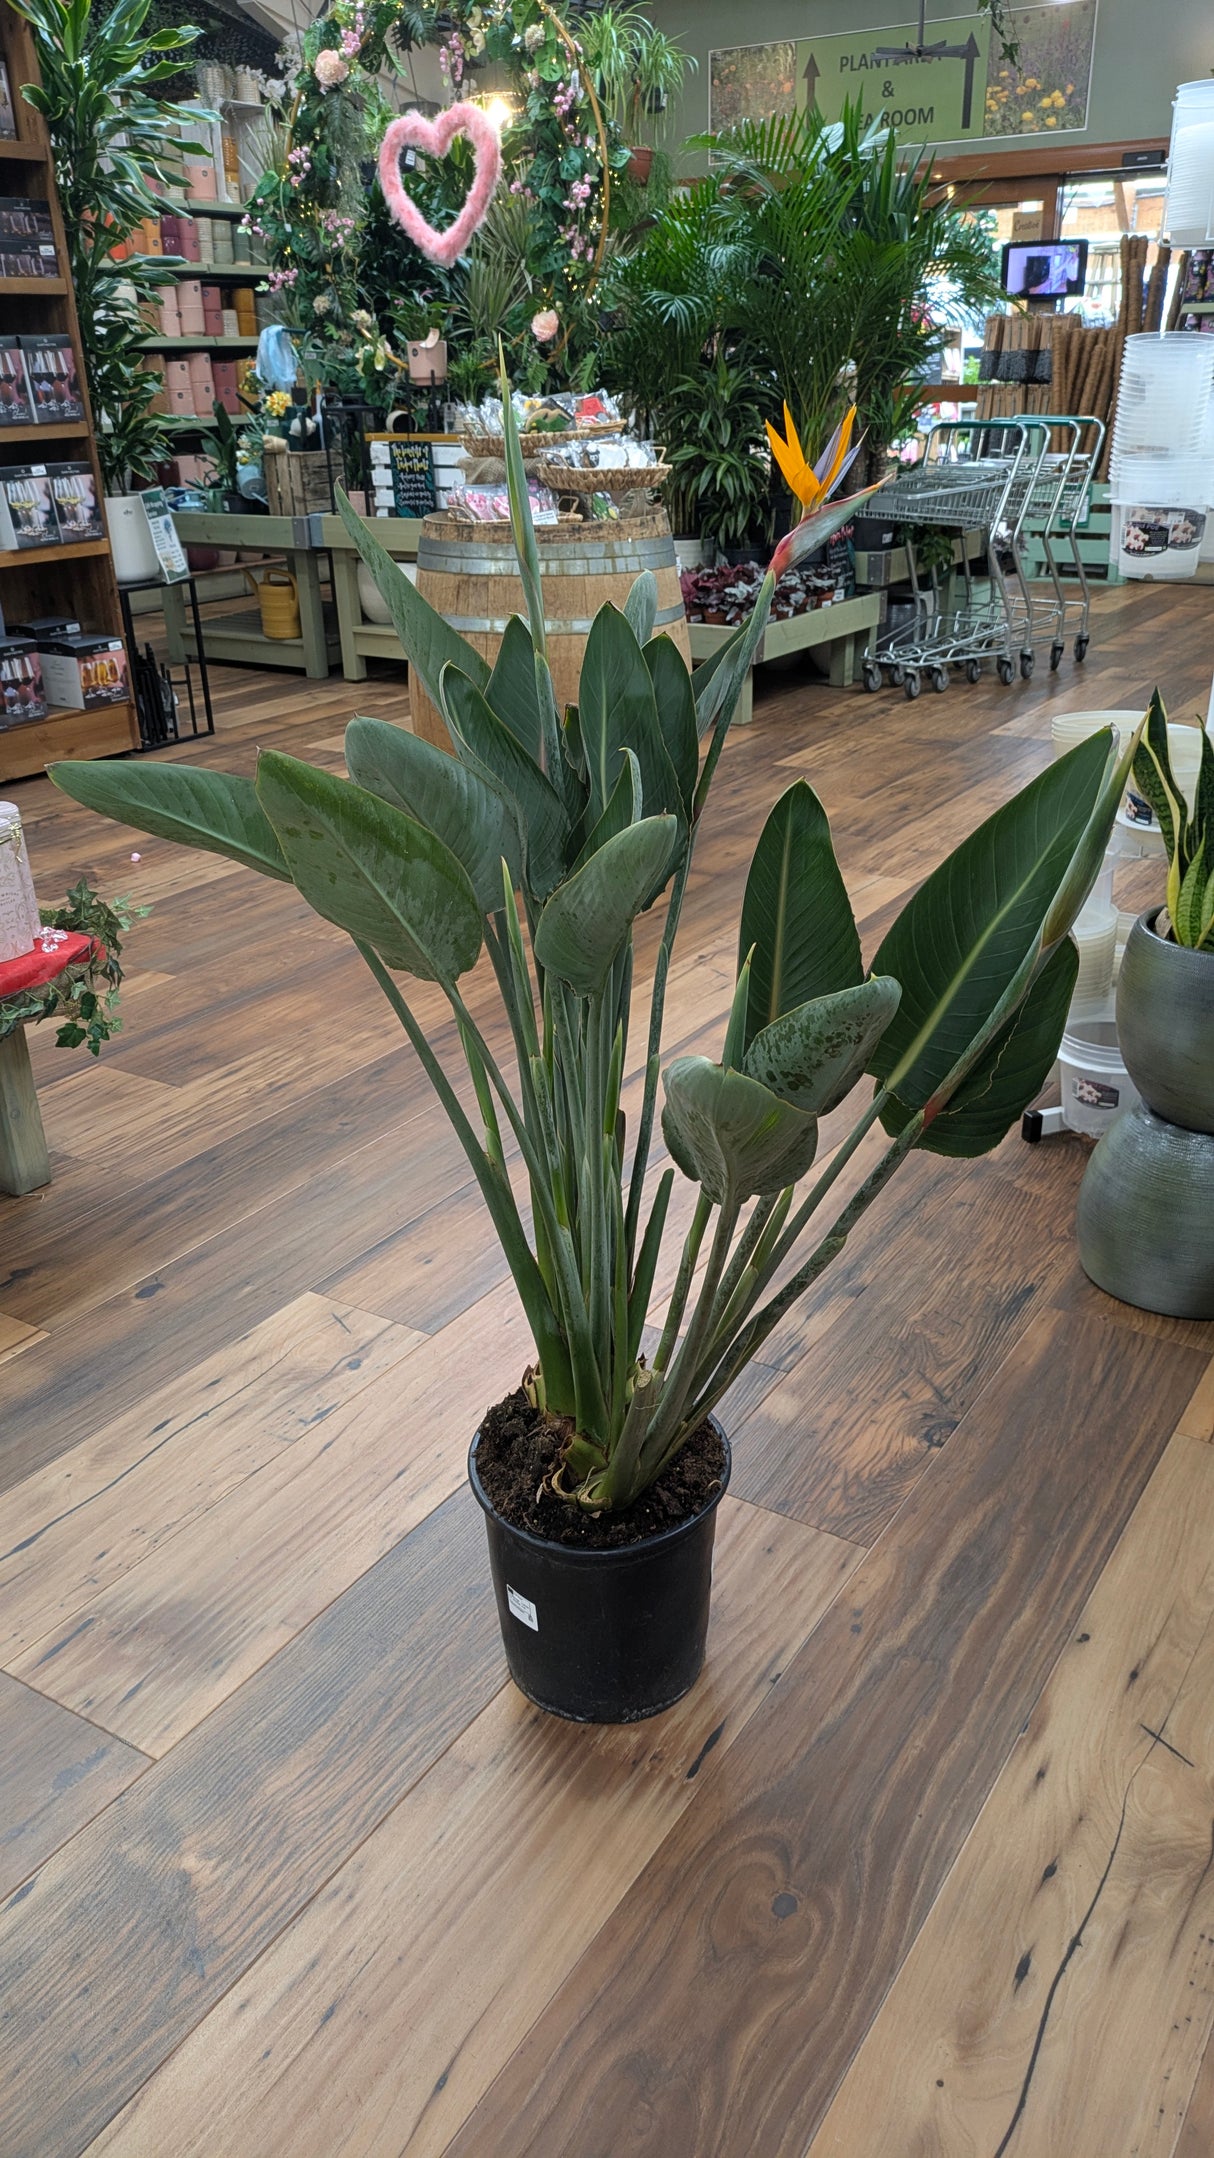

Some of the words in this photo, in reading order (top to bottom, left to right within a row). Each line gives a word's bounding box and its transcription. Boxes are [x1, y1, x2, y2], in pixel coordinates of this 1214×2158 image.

[881, 80, 895, 98] &
[856, 112, 875, 131] EA
[880, 106, 934, 128] ROOM
